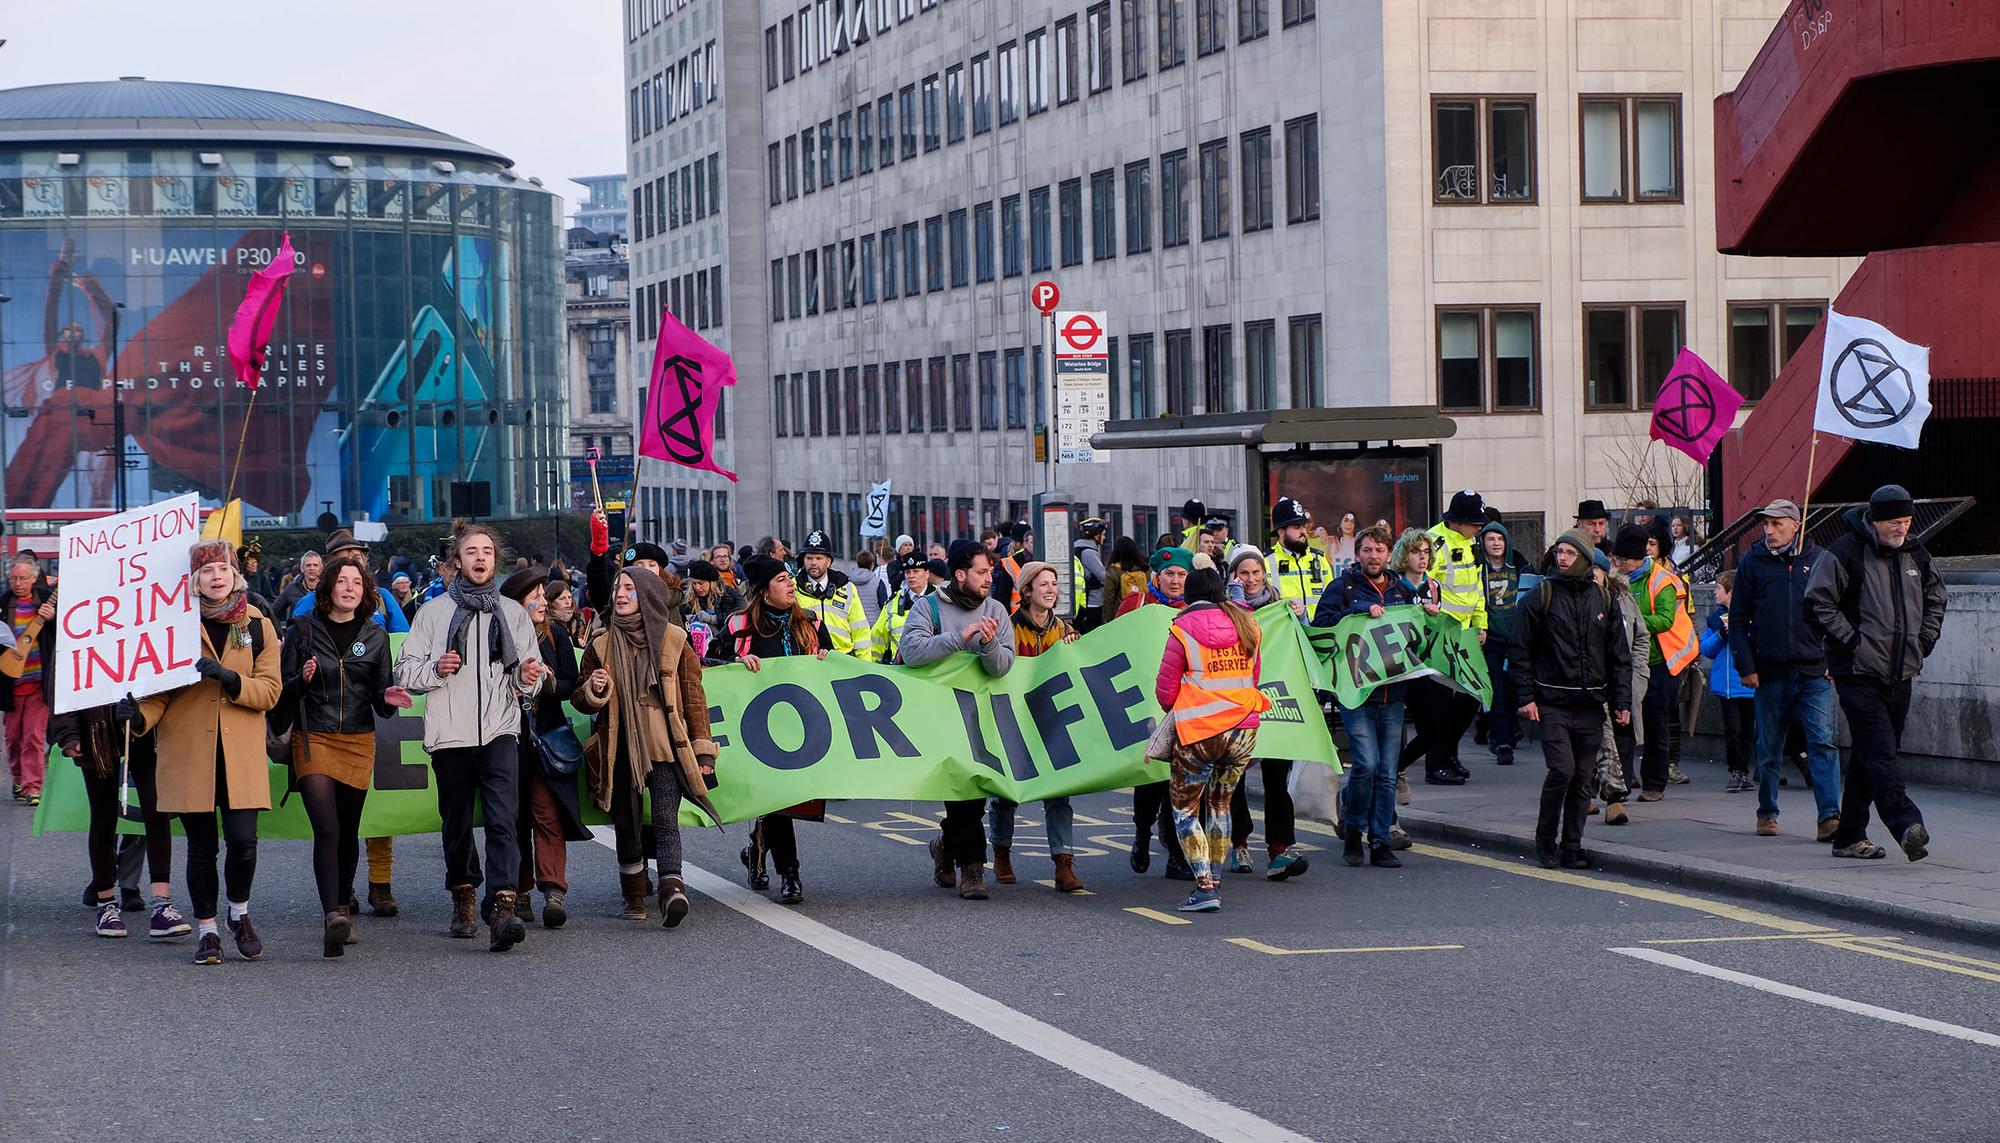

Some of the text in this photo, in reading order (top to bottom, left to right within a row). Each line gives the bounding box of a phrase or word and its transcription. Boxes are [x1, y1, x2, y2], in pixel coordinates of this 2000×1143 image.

[131, 248, 227, 265] HUAWEI
[237, 248, 271, 265] P30
[1040, 286, 1054, 307] P
[194, 345, 325, 358] RERITE
[160, 360, 325, 374] THE ULES
[1384, 473, 1419, 483] Meghan
[69, 503, 197, 559] INACTION
[251, 519, 283, 527] IMAX
[118, 552, 148, 587] IS
[63, 573, 192, 640] CRIM
[72, 626, 193, 691] INAL
[1210, 646, 1245, 659] LEGAL
[1207, 658, 1251, 673] OBSERVER
[952, 652, 1157, 781] LIFE
